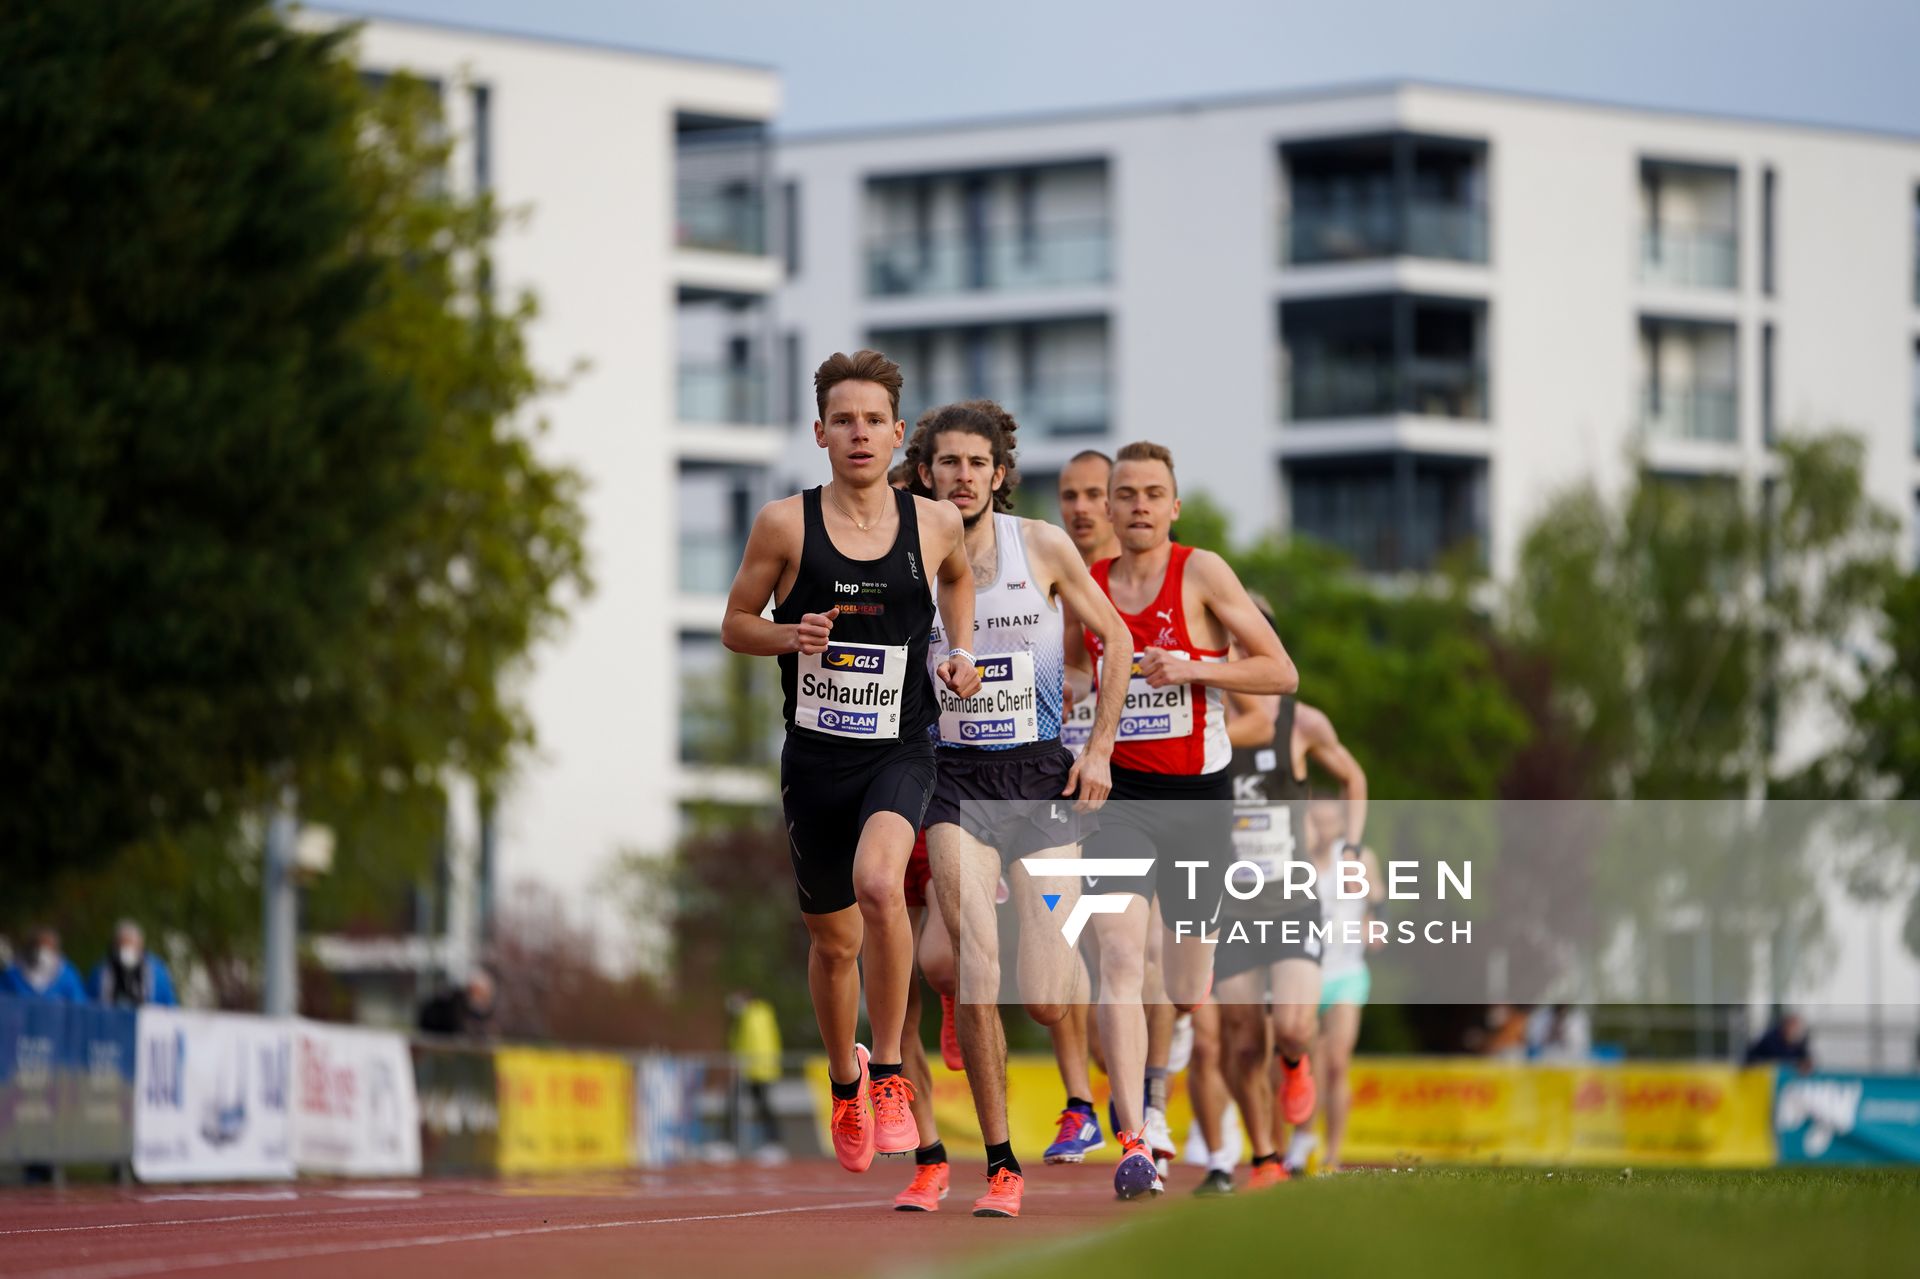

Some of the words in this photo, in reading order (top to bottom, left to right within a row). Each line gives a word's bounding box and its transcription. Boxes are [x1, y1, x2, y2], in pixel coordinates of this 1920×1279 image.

[907, 551, 919, 580] 2XU
[834, 580, 860, 595] hep
[987, 614, 1040, 629] FINANZ
[854, 655, 880, 669] GLS
[984, 664, 1008, 678] GLS
[802, 673, 899, 706] Schaufler
[1125, 685, 1185, 709] enzel
[940, 689, 994, 714] Ramdane
[997, 687, 1032, 712] Cherif
[841, 715, 875, 727] PLAN
[981, 722, 1013, 733] PLAN
[1138, 718, 1169, 729] PLAN
